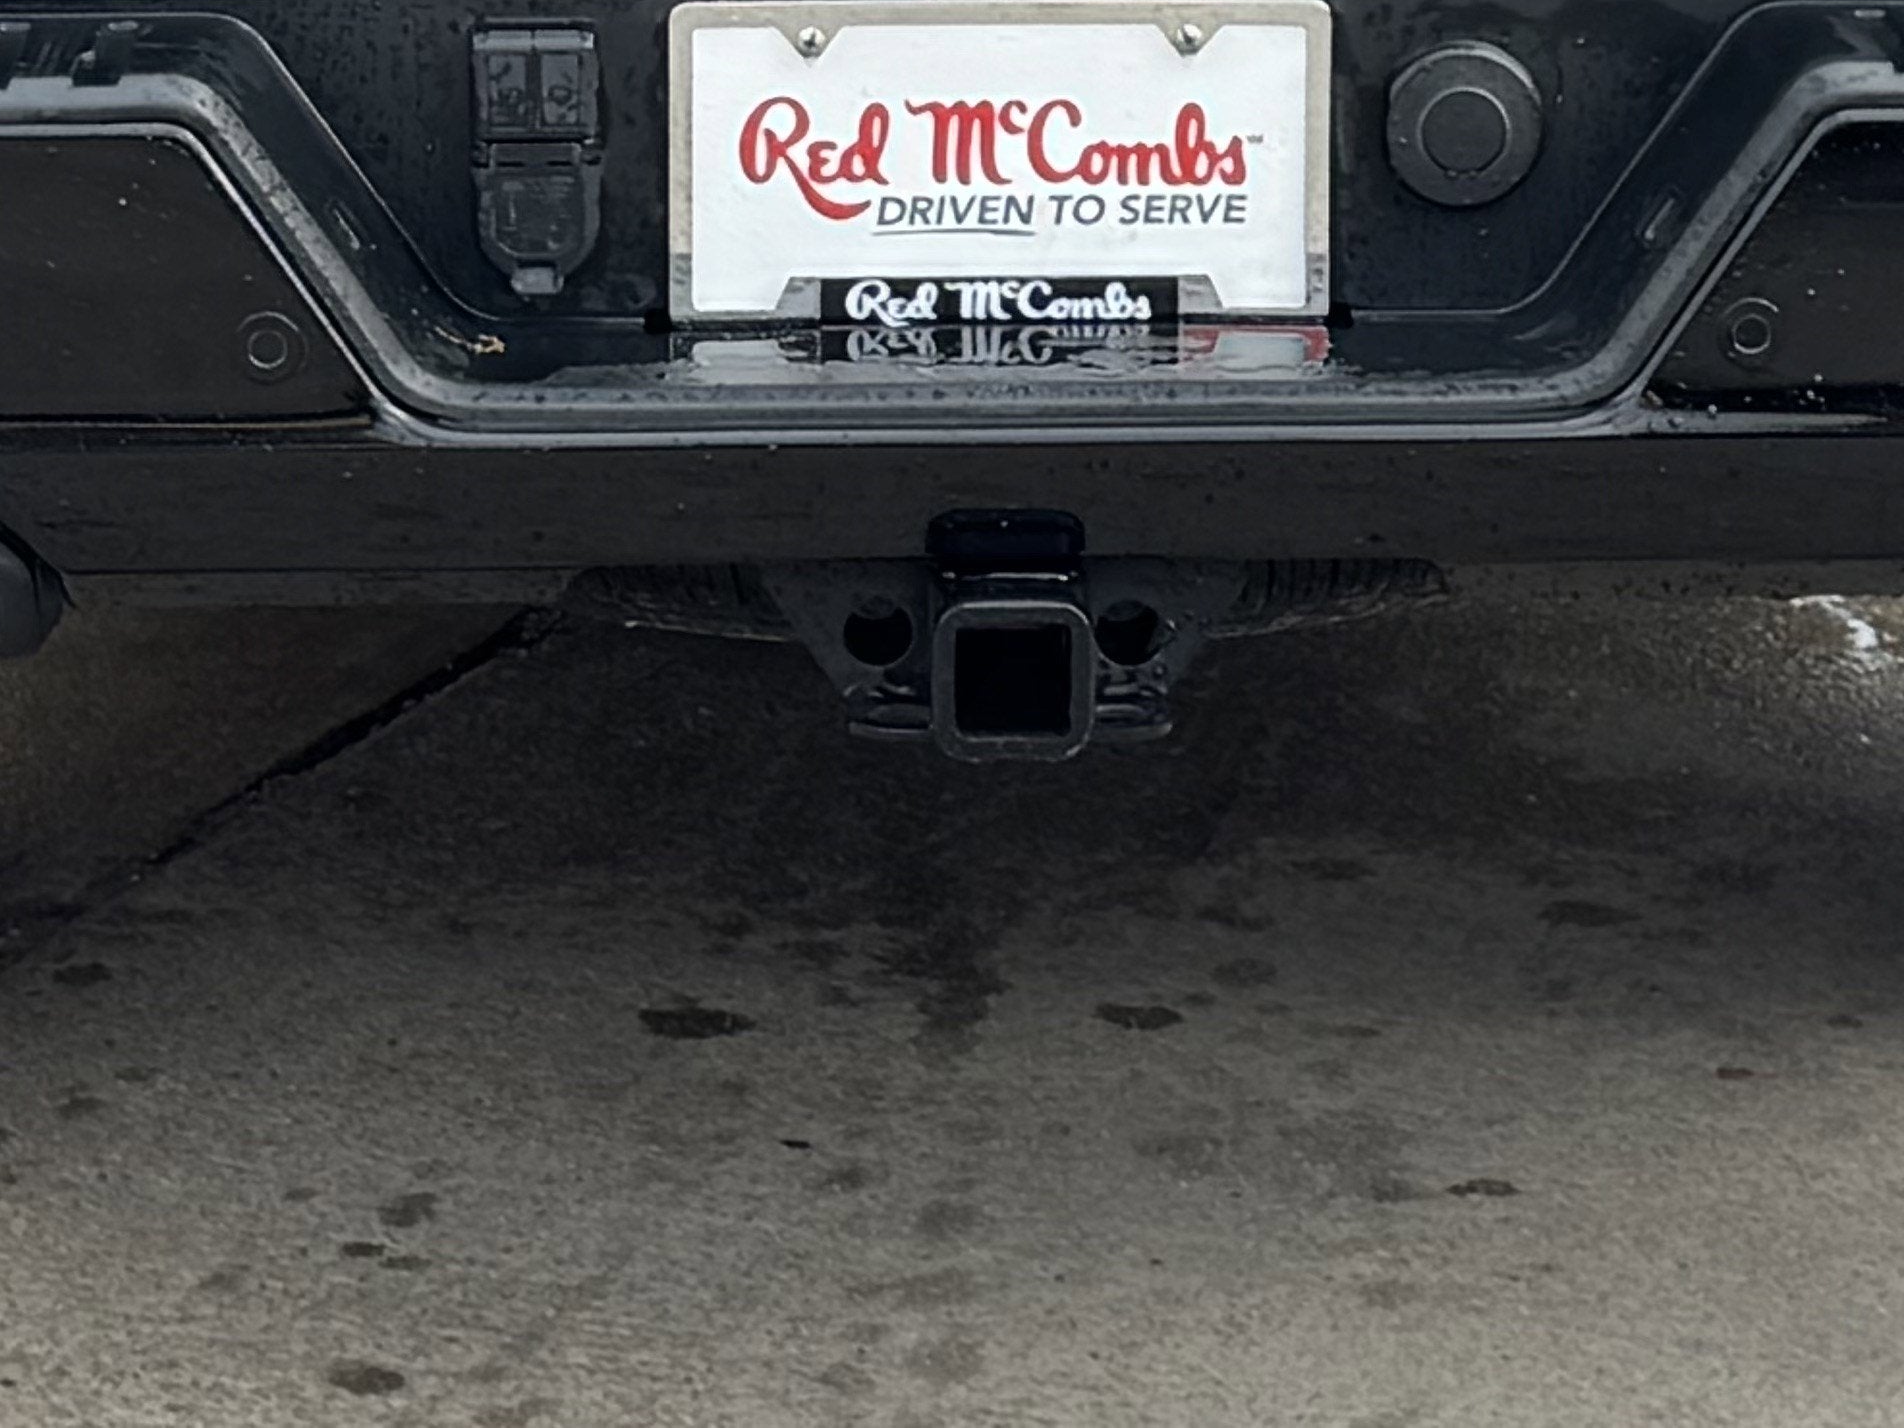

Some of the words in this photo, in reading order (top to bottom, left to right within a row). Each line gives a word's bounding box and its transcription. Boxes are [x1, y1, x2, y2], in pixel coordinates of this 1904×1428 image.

[739, 96, 890, 221] Red
[904, 98, 1248, 186] McCombs
[876, 194, 1036, 226] DRIVEN
[1048, 194, 1106, 225] TO
[1118, 194, 1248, 225] SERVE
[845, 279, 938, 327] Red
[944, 280, 1152, 320] McCombs
